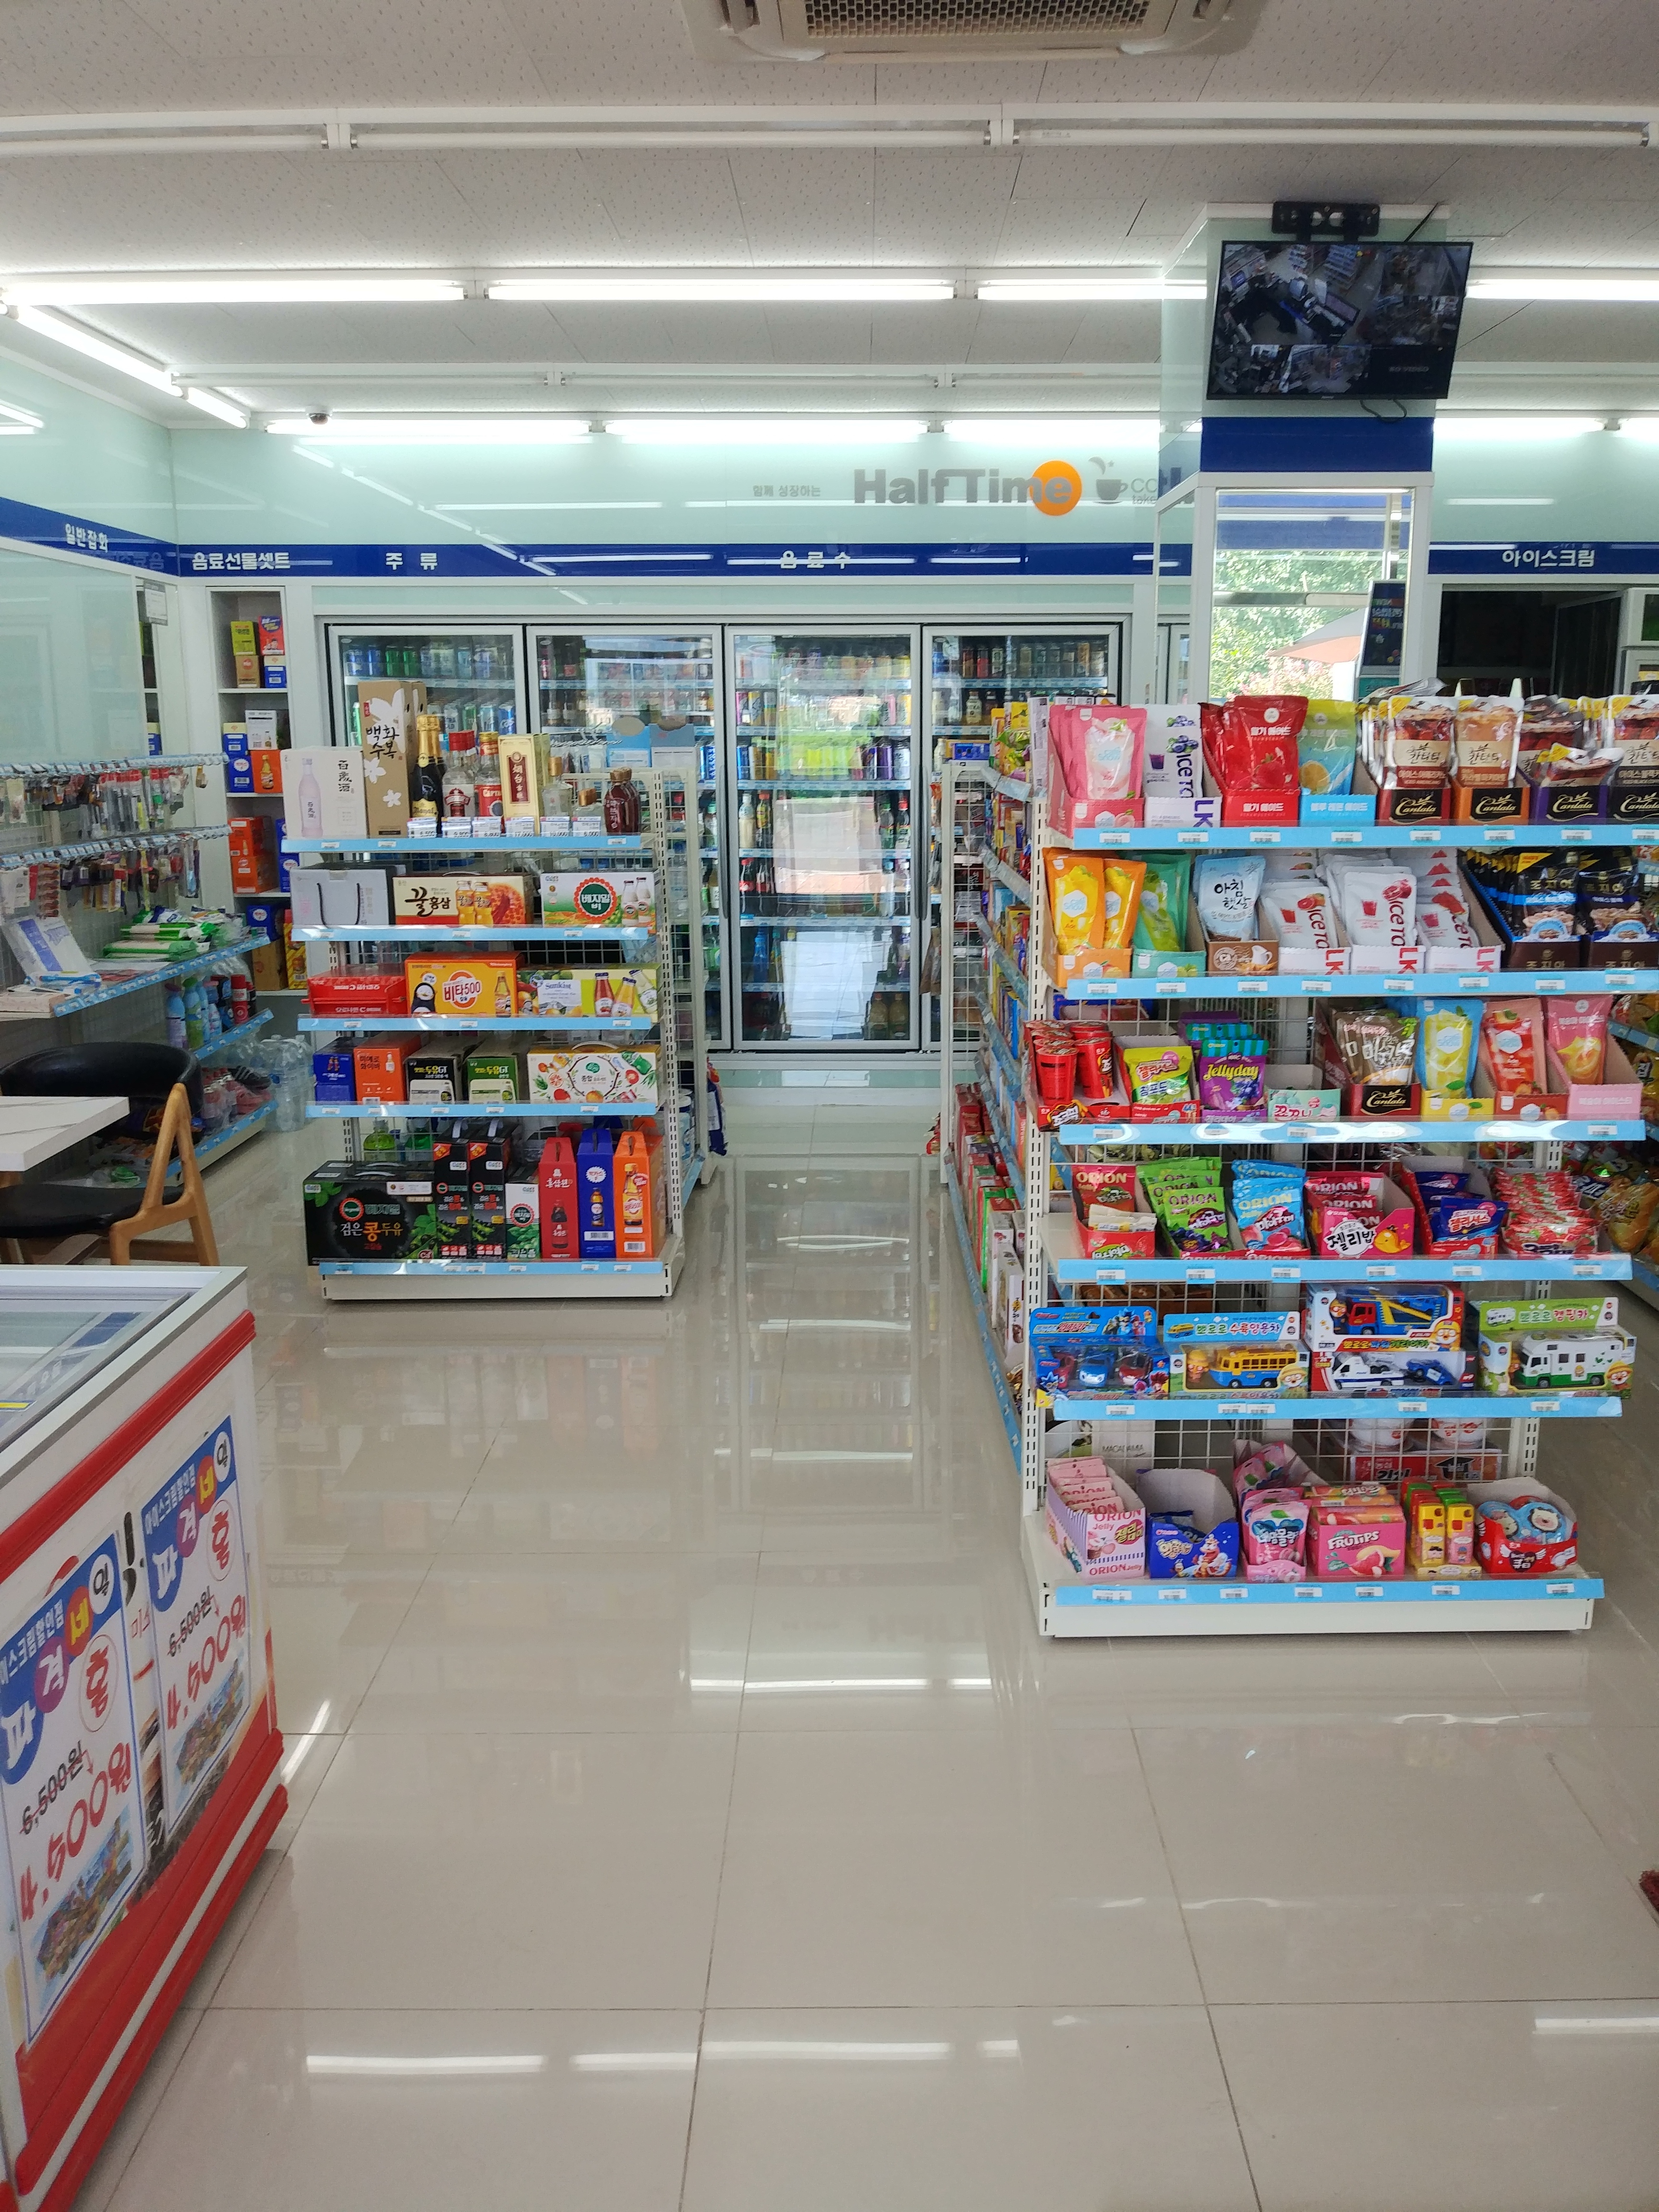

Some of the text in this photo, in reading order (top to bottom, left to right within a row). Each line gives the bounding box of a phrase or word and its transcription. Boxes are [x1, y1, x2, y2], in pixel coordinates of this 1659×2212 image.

[778, 485, 821, 497] 성장하는
[65, 523, 108, 553] 일반잡화
[192, 552, 291, 571] 음료선물셋트
[1502, 550, 1595, 568] 아이스크림
[366, 725, 400, 741] 백화
[369, 741, 398, 759] 수복
[1214, 879, 1244, 897] 아침
[1222, 896, 1252, 911] 햇살
[444, 981, 481, 1001] 비타500
[1203, 1063, 1259, 1081] Jellyday
[1075, 1171, 1127, 1184] ORION
[1169, 1193, 1217, 1206] ORION
[1239, 1193, 1292, 1210] ORION
[1326, 1231, 1375, 1251] 젤리밥
[1553, 1308, 1588, 1322] 캠핑카
[1197, 1322, 1280, 1336] 뽀로로 수륙양용차
[1089, 1564, 1126, 1577] ORION
[169, 1585, 212, 1657] 6,500원
[21, 1740, 84, 1835] 6,500원
